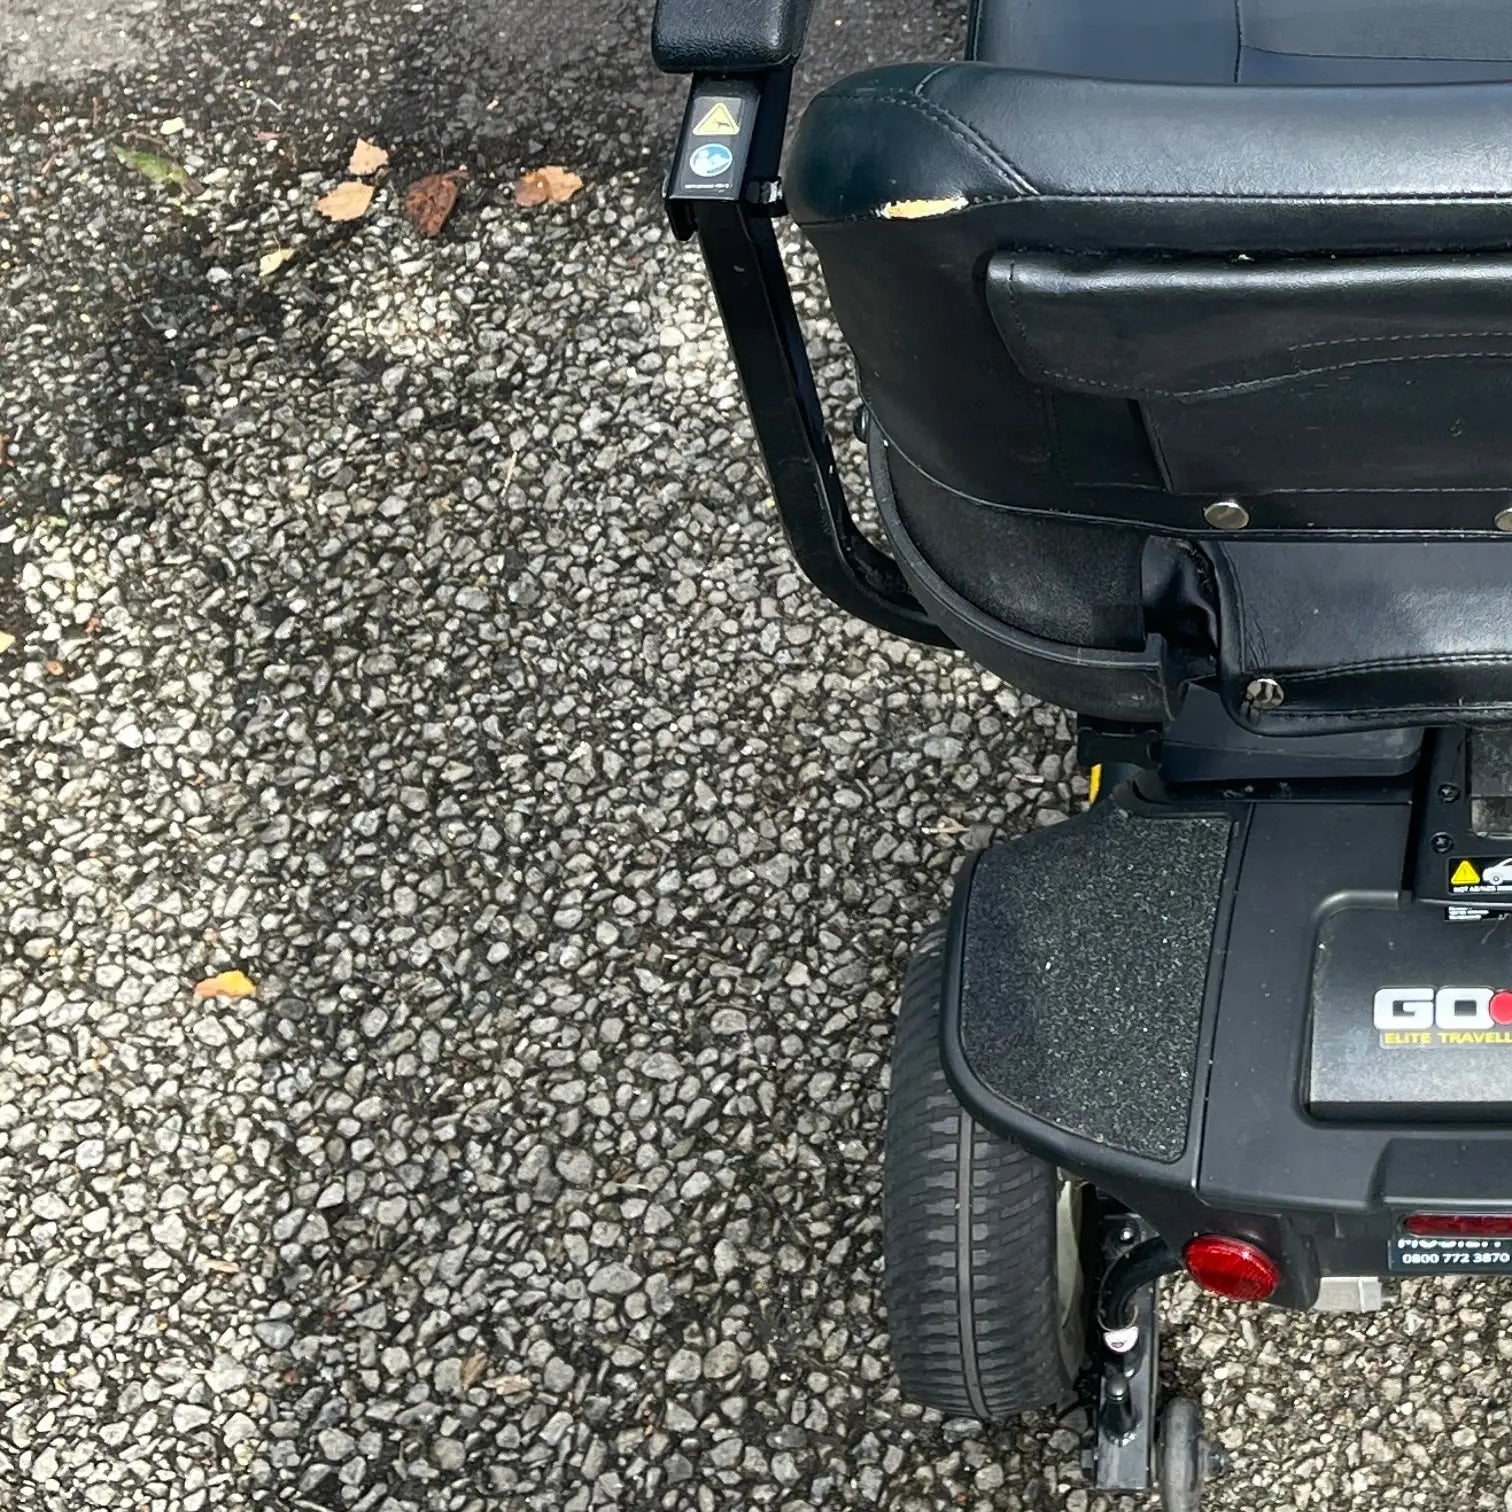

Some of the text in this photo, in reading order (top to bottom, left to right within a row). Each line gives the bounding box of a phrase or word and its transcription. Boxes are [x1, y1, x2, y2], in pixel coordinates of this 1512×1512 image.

[1384, 1031, 1431, 1045] ELITE
[1402, 1251, 1511, 1264] 0800 772 3870
